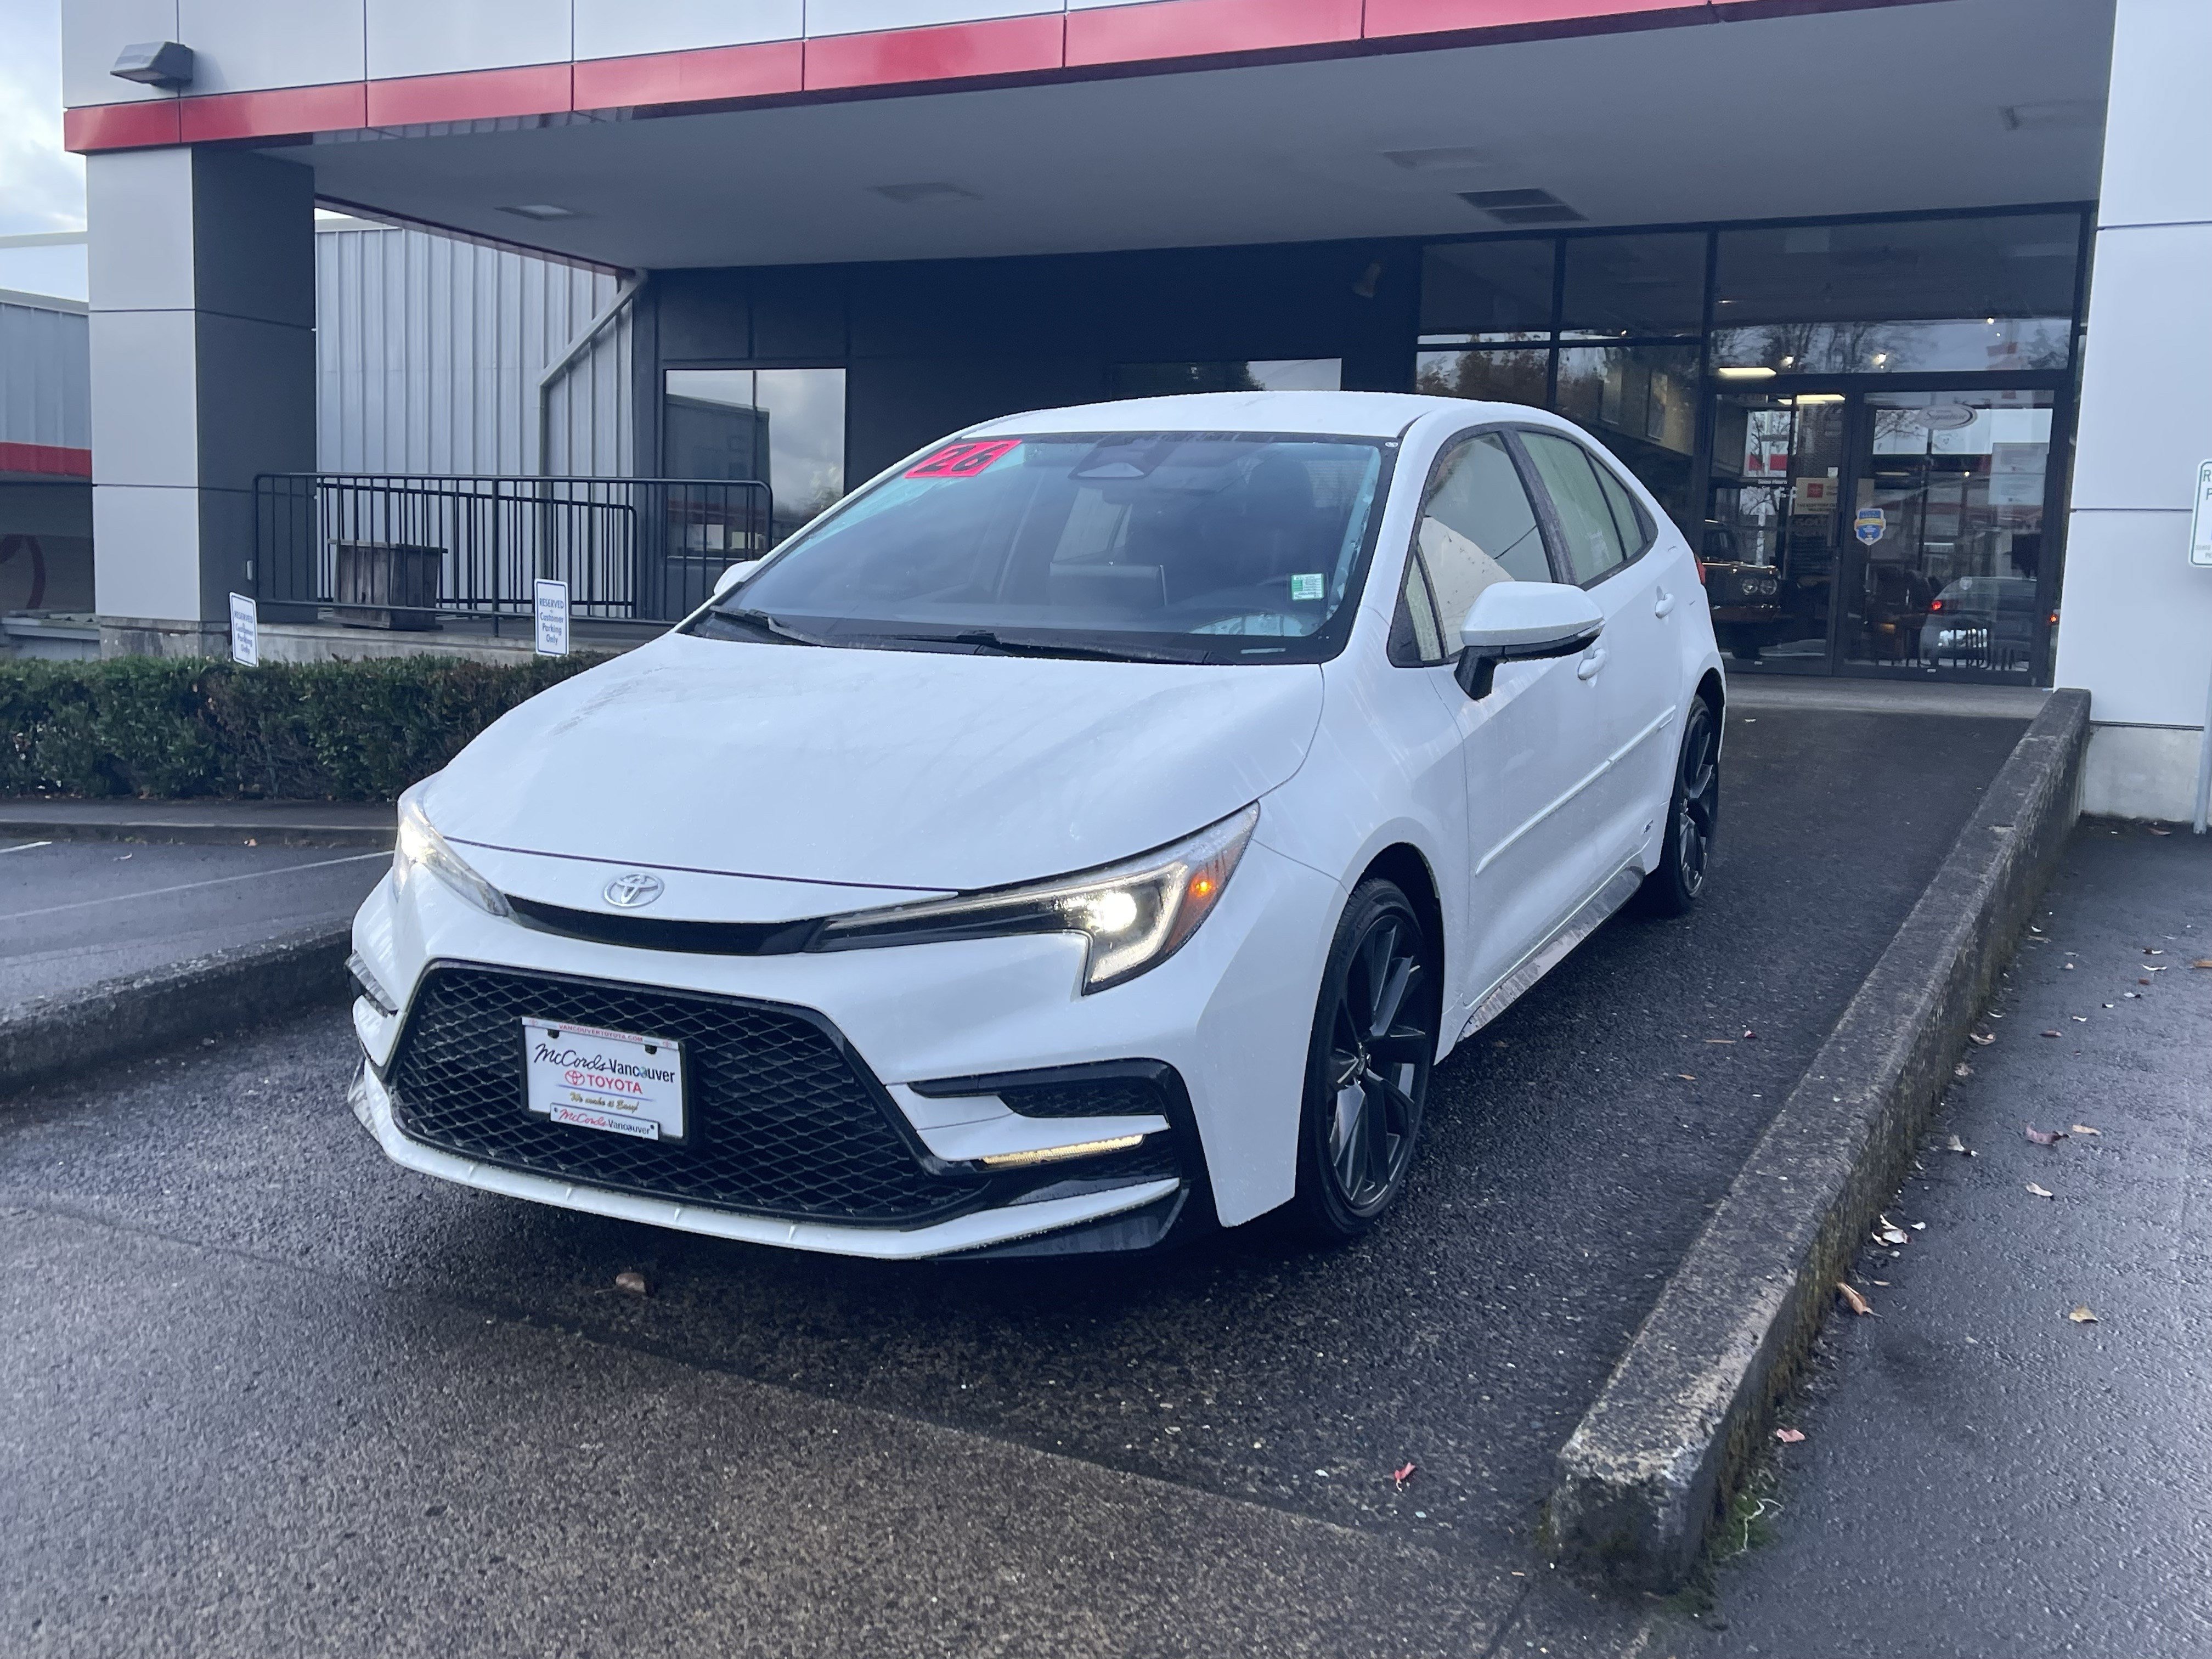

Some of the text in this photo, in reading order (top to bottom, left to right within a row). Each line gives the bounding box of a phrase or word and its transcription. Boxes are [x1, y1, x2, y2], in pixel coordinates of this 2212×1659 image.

[913, 443, 1008, 473] 26
[539, 597, 564, 609] RESERVED
[540, 612, 564, 623] Customer
[542, 623, 562, 636] Parking
[546, 634, 558, 646] Only
[608, 1058, 675, 1083] Vancouver
[586, 1074, 643, 1094] TOYOTA
[608, 1119, 650, 1135] Vancouver
